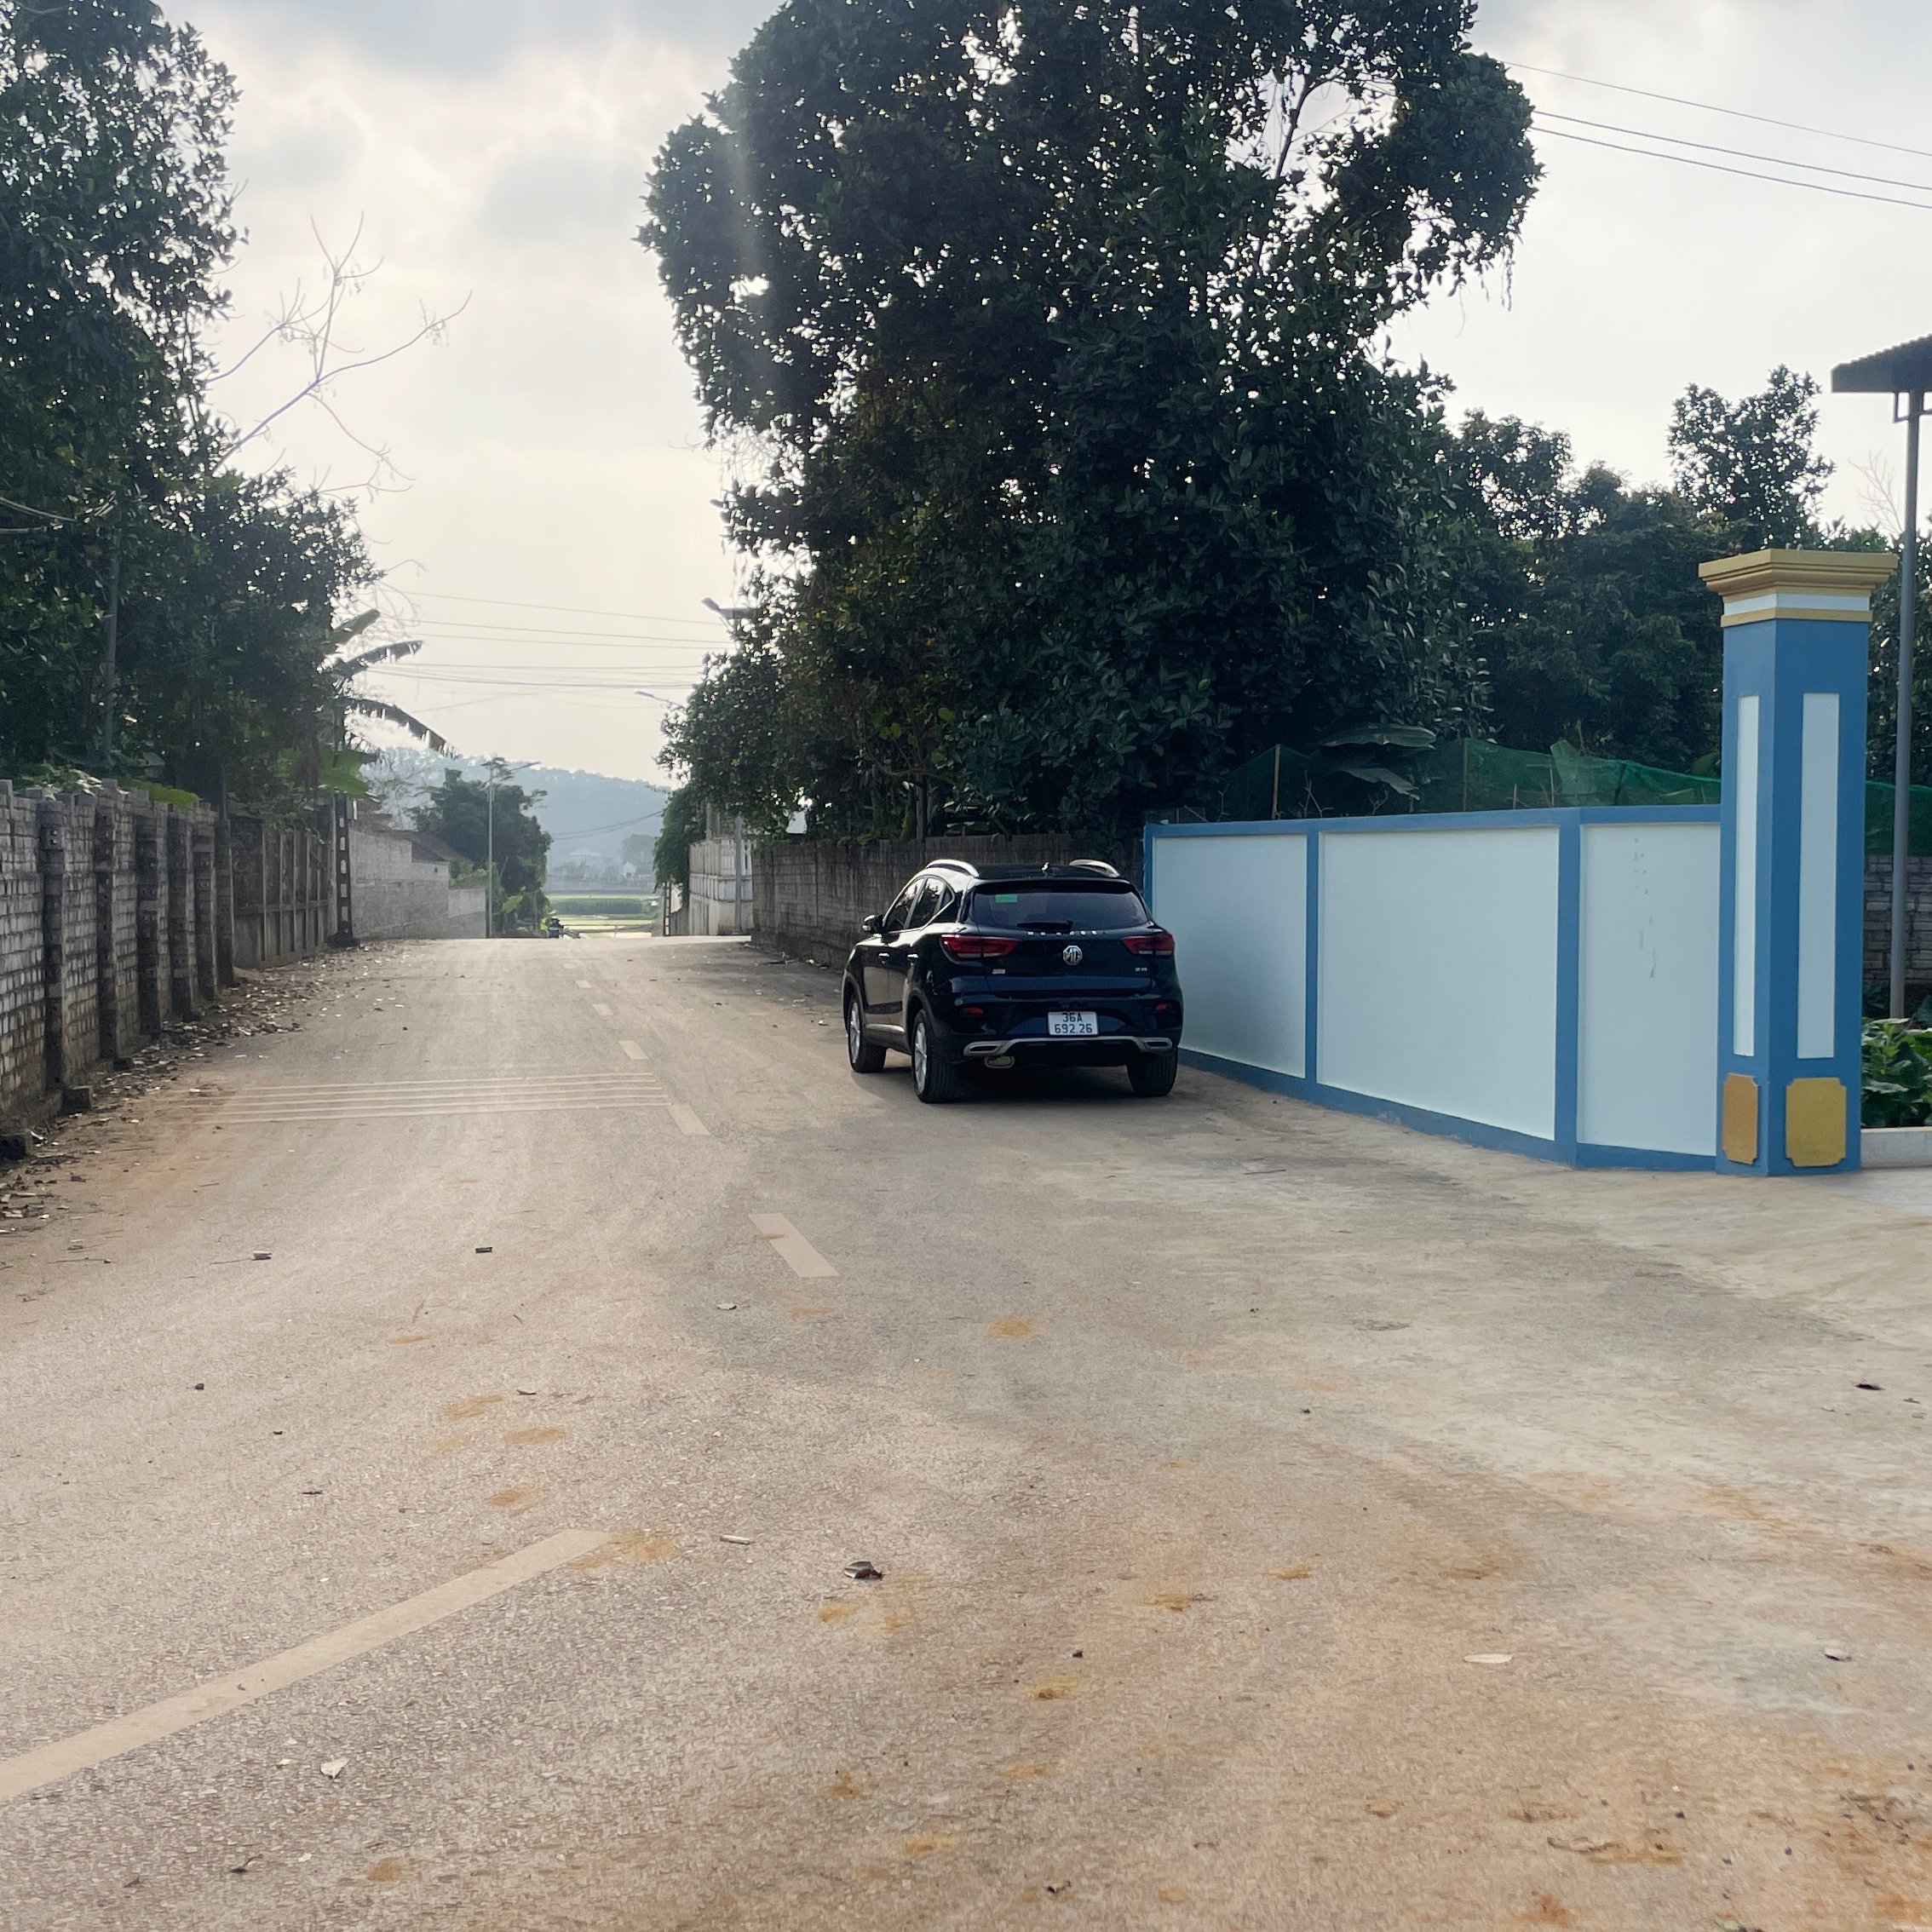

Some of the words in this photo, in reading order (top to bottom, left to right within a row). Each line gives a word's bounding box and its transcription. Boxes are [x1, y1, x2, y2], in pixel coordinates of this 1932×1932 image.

[1063, 946, 1083, 965] MG
[1061, 1012, 1083, 1022] 36A
[1054, 1023, 1093, 1034] 692.26
